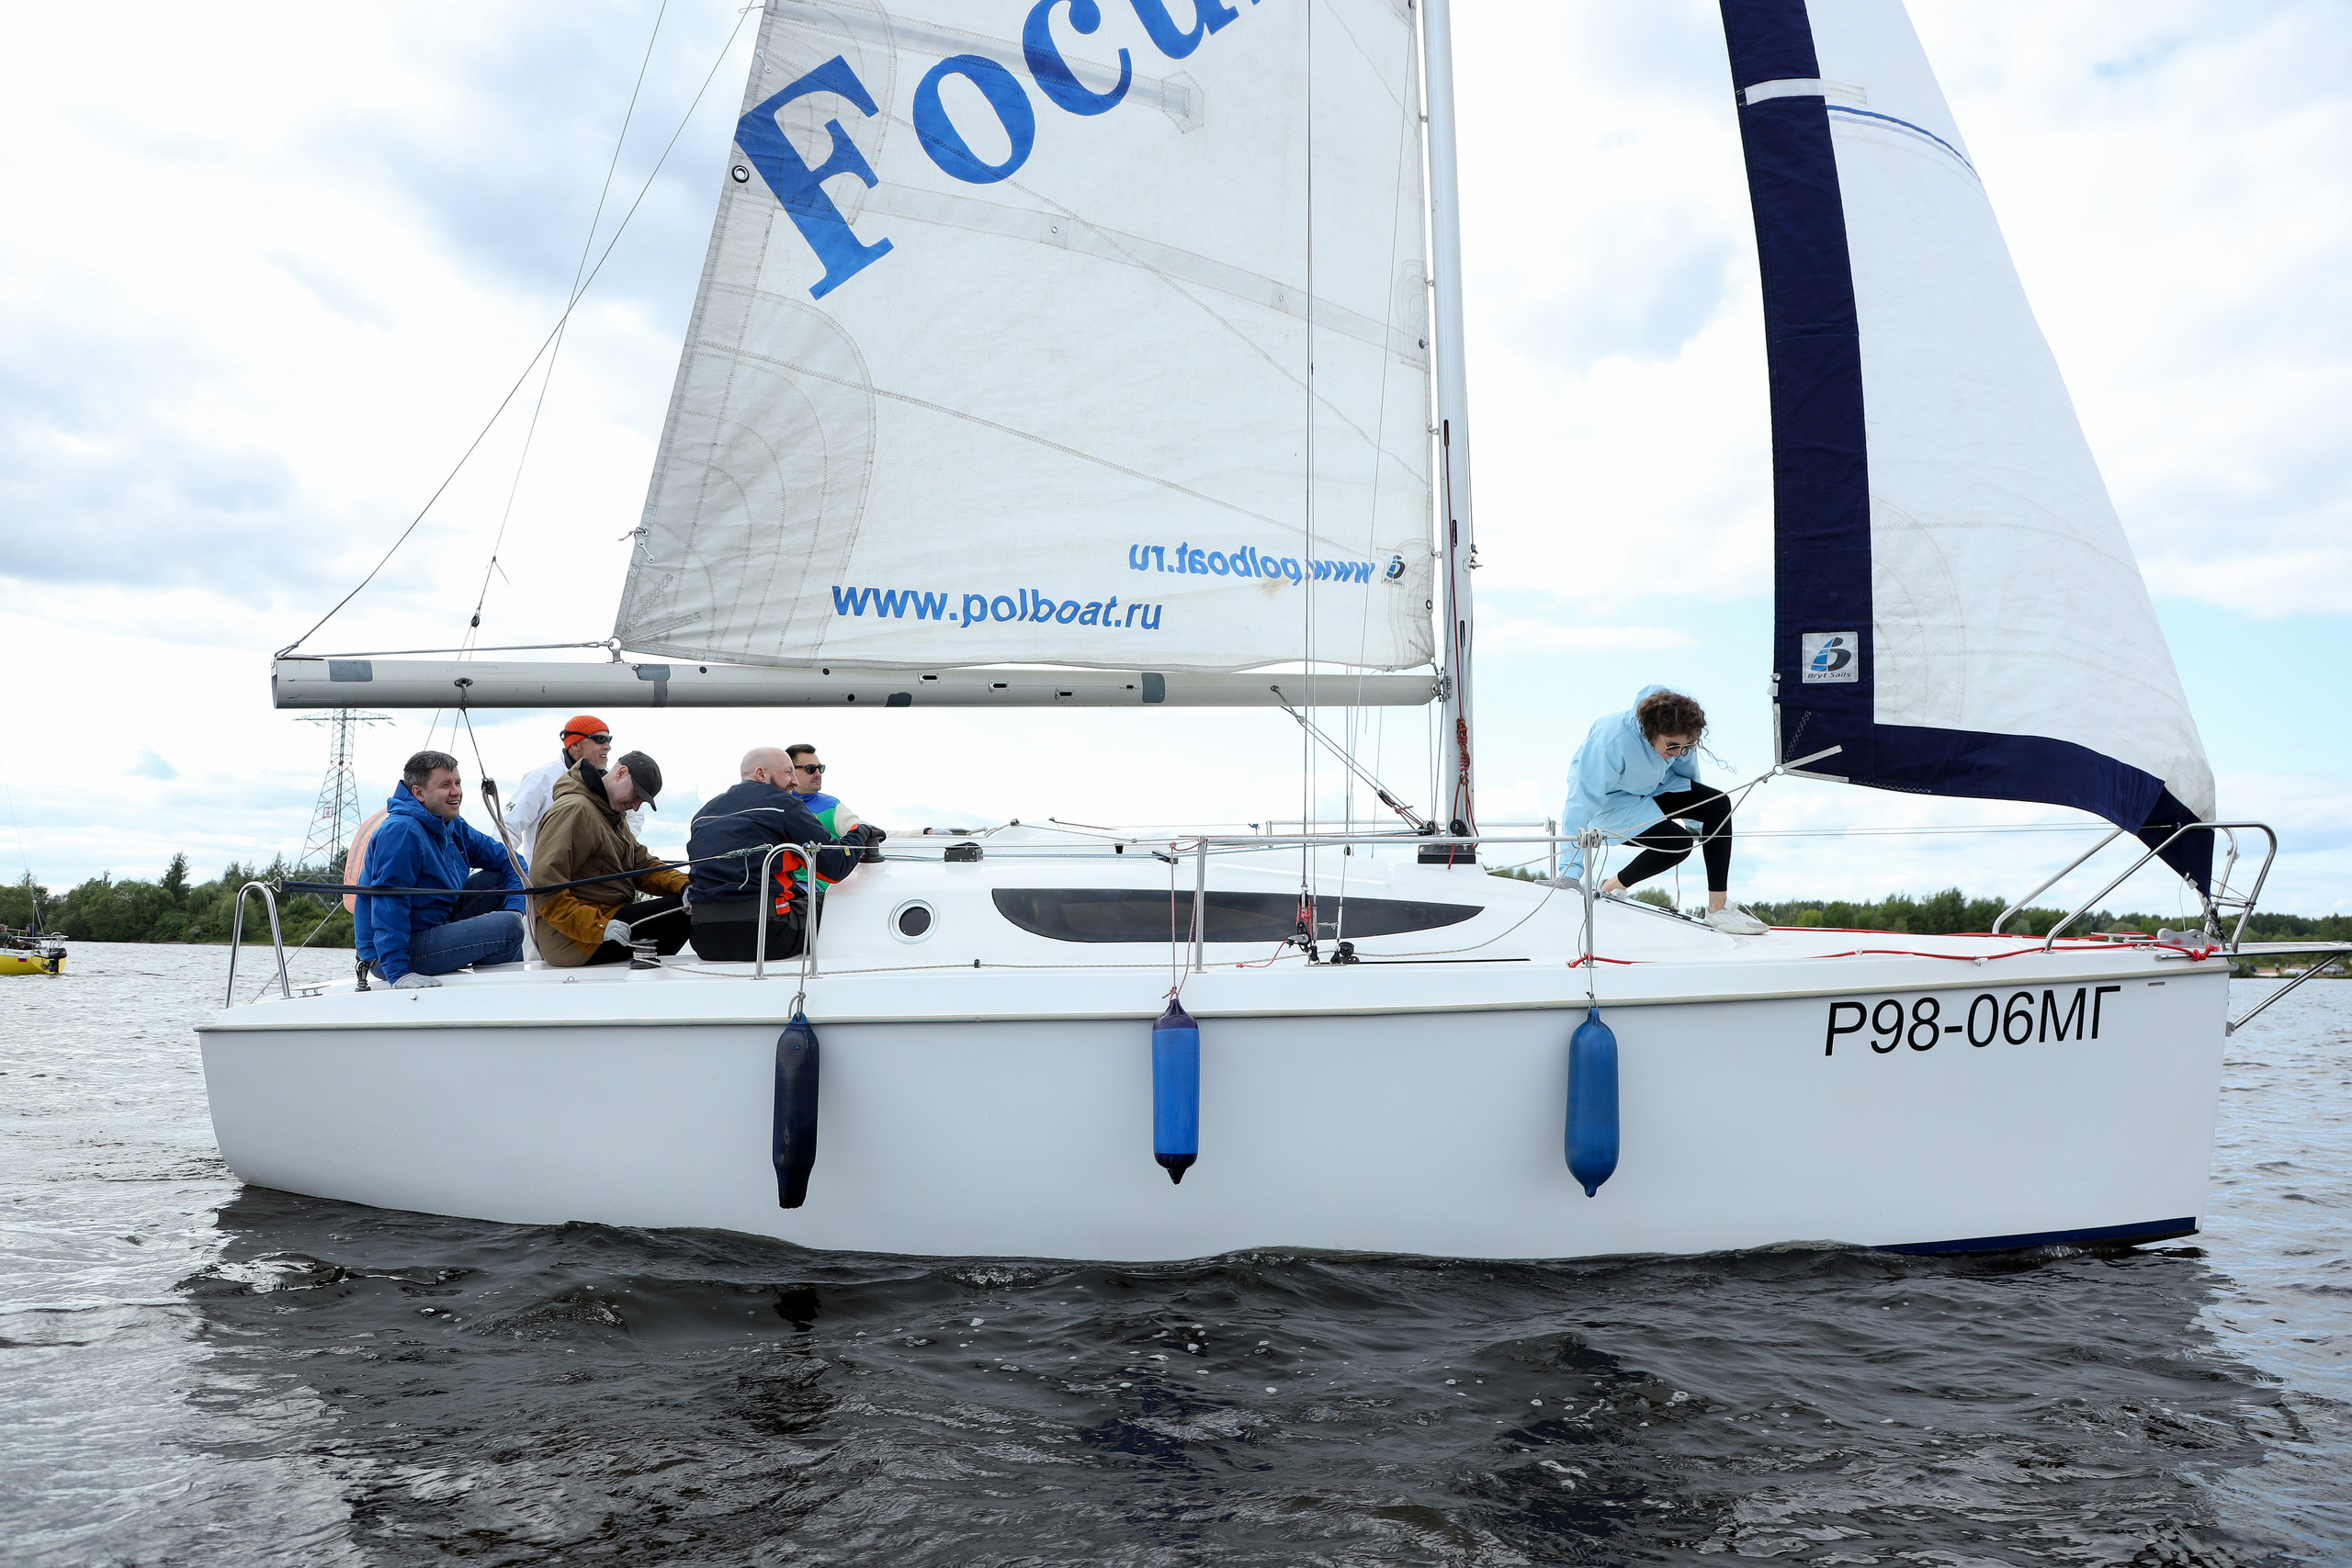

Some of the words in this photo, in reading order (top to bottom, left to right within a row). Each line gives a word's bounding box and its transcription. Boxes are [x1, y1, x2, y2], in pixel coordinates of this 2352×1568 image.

[734, 0, 1261, 300] Focu
[831, 585, 1163, 630] www.polboat.ru
[1825, 985, 2121, 1057] Р98-06МГ
